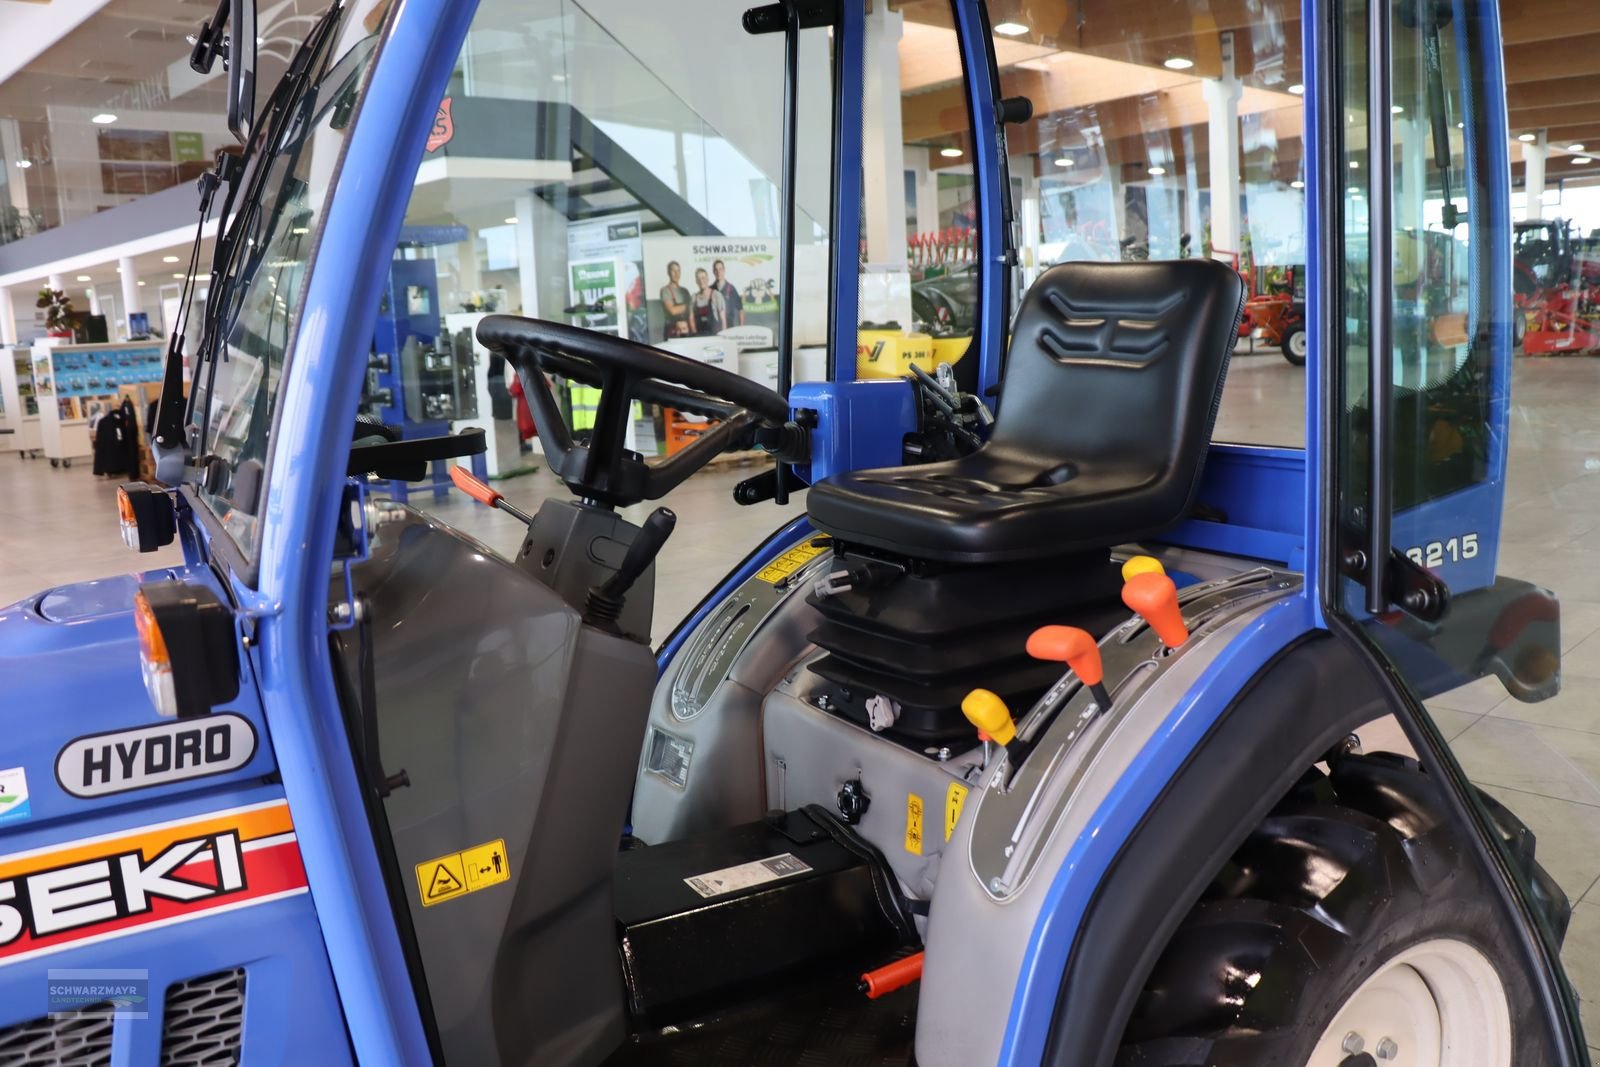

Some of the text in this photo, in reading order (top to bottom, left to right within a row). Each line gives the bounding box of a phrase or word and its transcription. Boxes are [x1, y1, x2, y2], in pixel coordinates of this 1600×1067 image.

[692, 244, 767, 254] SCHWARZMAYR
[83, 724, 231, 787] HYDRO
[0, 830, 246, 946] EKI
